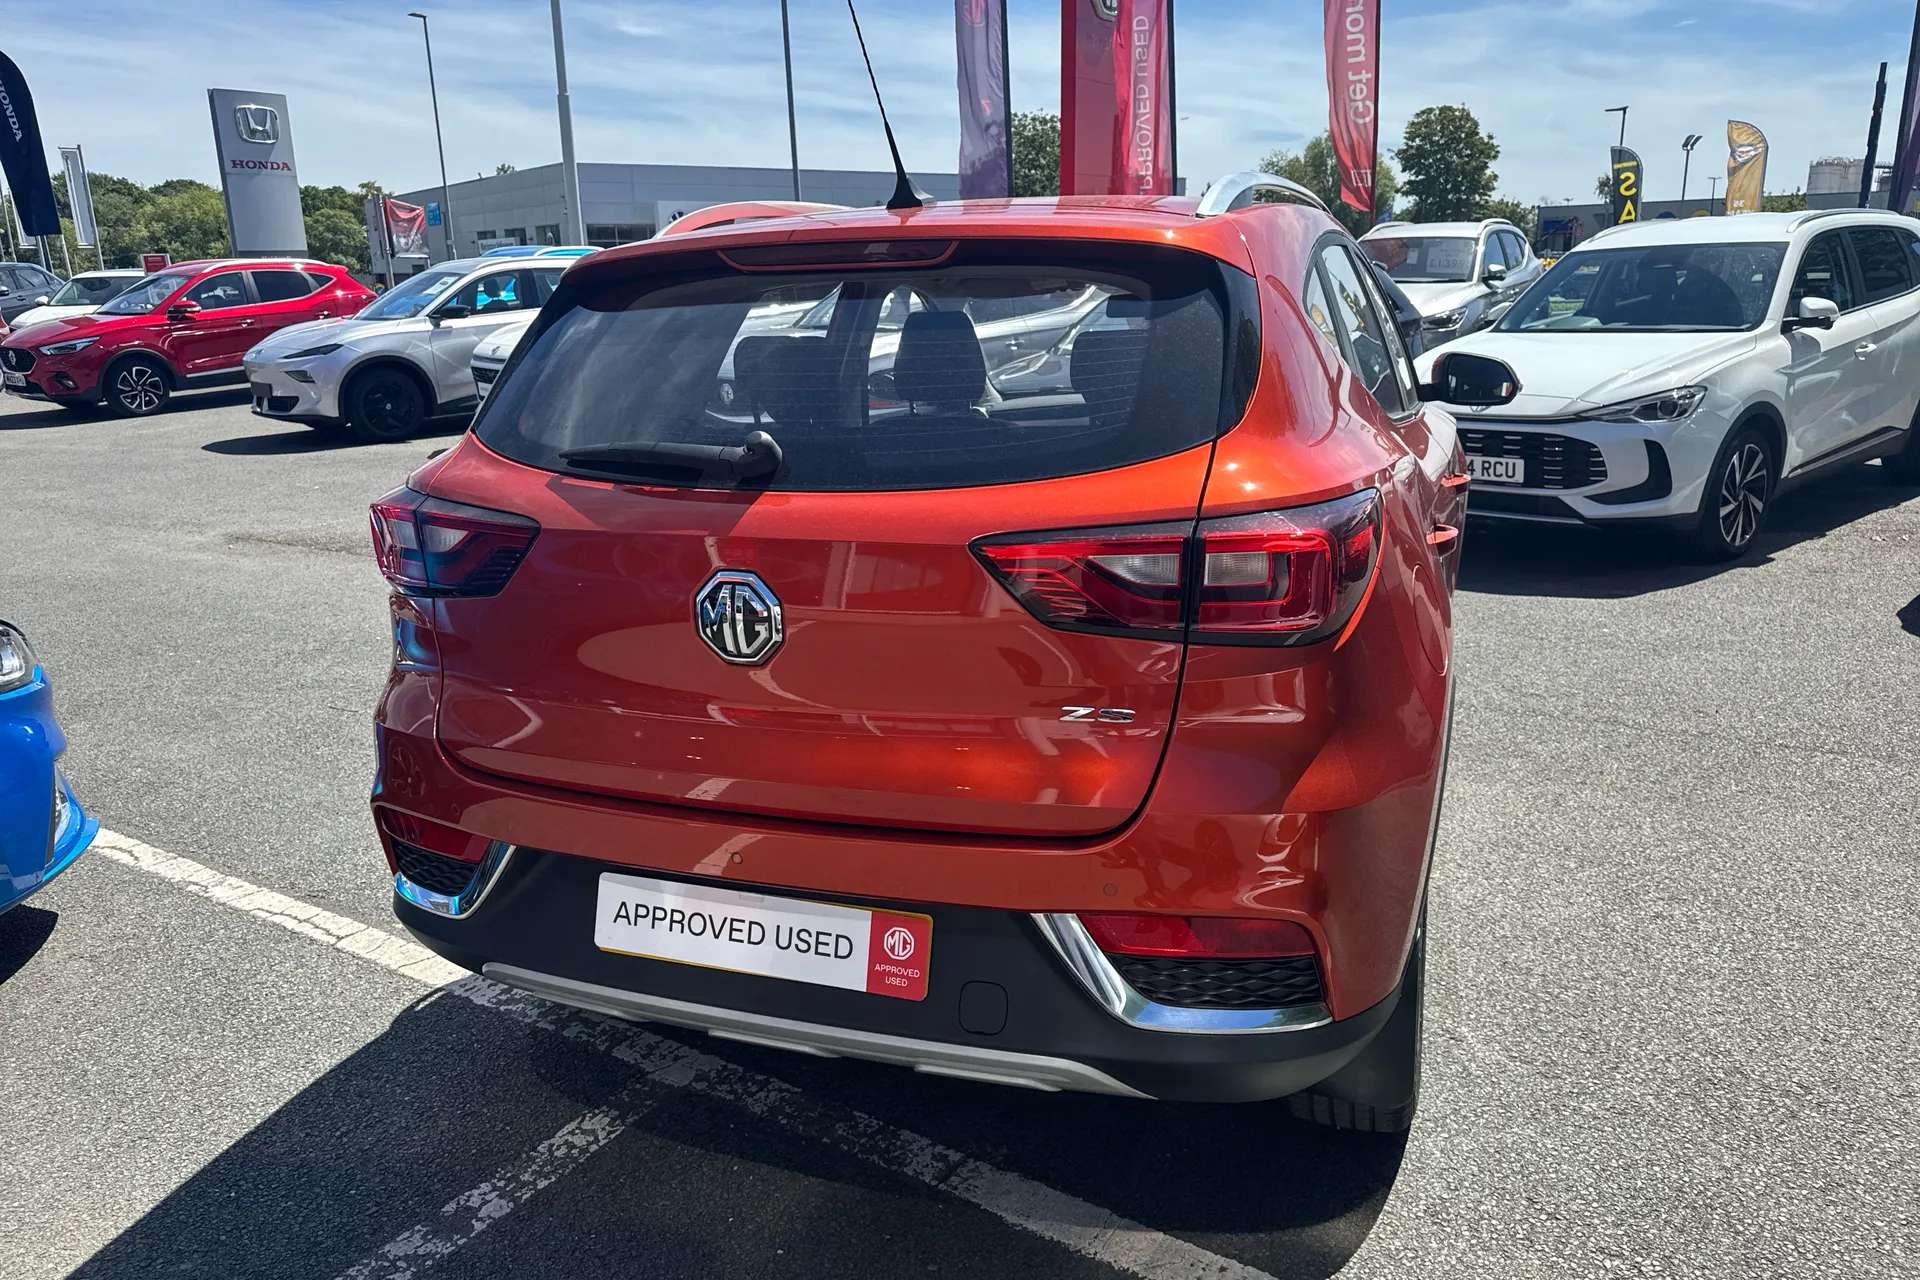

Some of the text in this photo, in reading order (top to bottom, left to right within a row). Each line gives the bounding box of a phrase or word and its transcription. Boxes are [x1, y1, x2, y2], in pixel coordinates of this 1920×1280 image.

[230, 159, 292, 171] HONDA
[1481, 460, 1516, 478] RCU
[700, 577, 779, 660] MG
[1059, 705, 1137, 723] ZS
[613, 901, 854, 960] APPROVED USED
[885, 928, 913, 959] MG
[874, 963, 920, 978] APPROVED
[885, 976, 908, 987] USED
